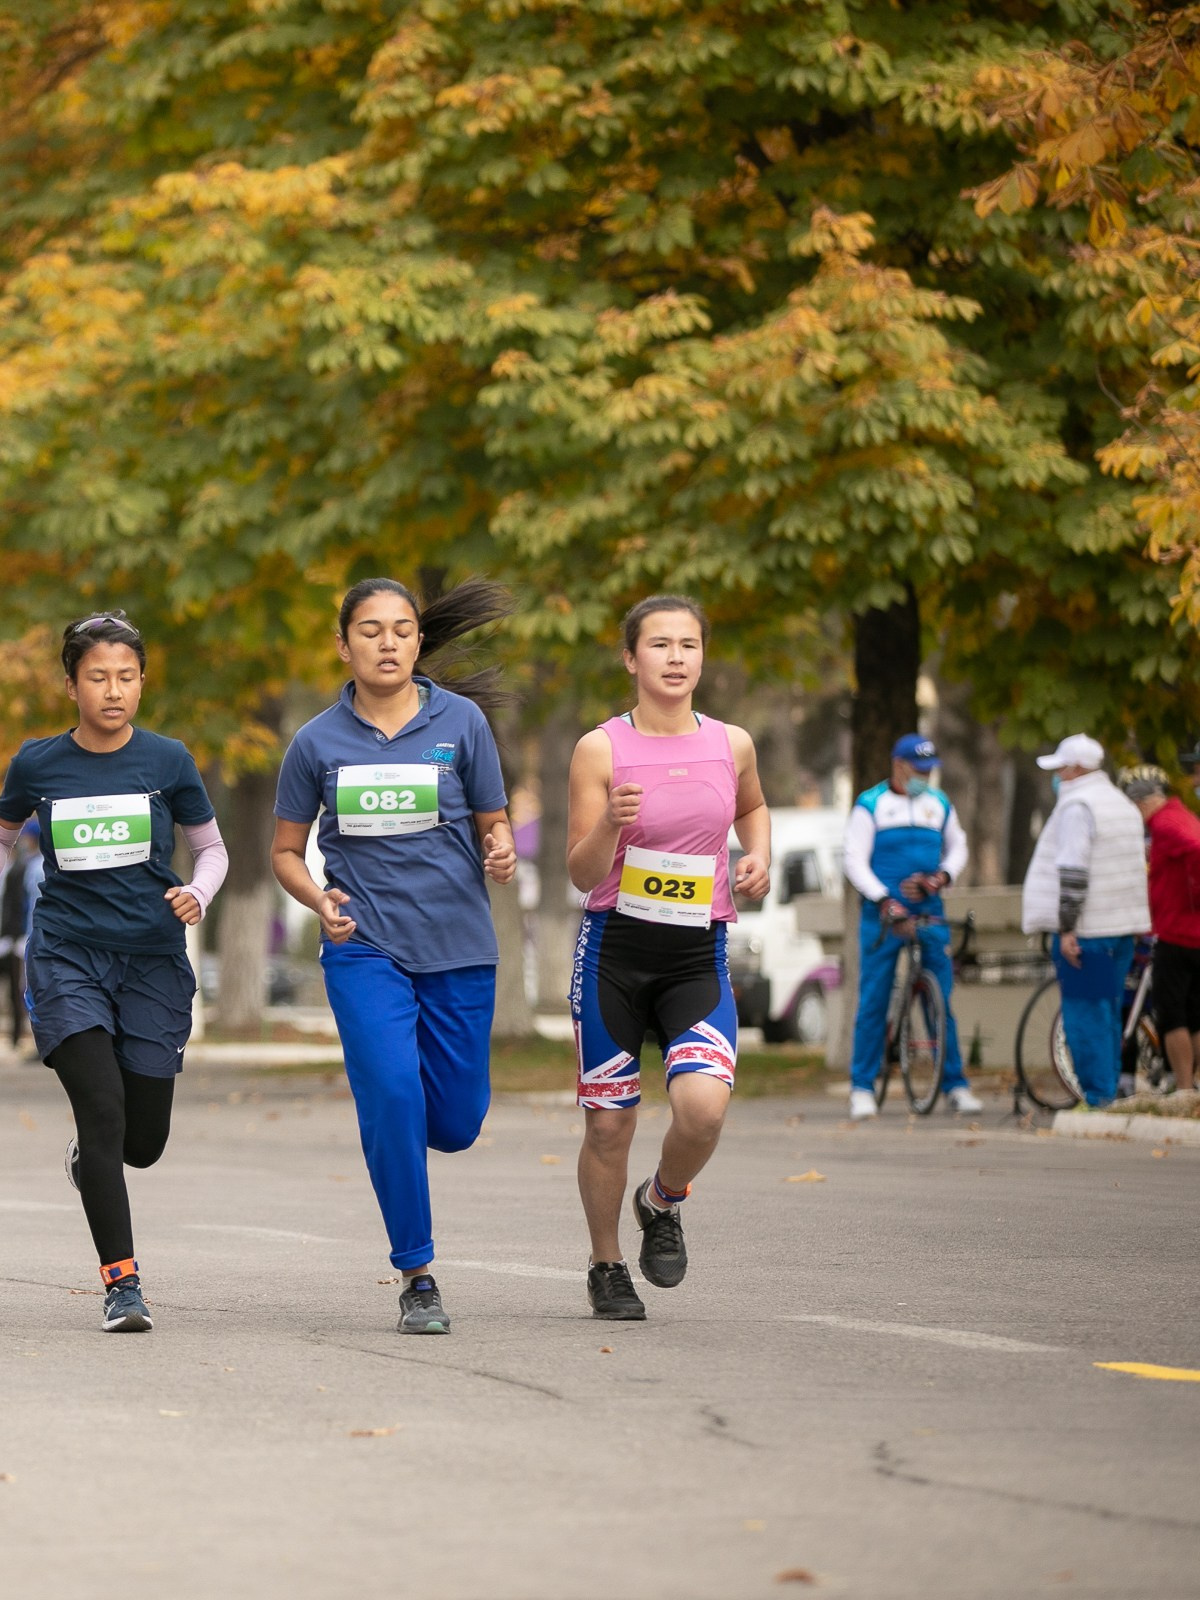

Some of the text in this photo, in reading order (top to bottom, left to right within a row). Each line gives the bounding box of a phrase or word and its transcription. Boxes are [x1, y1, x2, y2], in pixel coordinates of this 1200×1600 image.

[359, 789, 416, 811] 082
[73, 820, 130, 844] 048
[643, 876, 696, 899] 023
